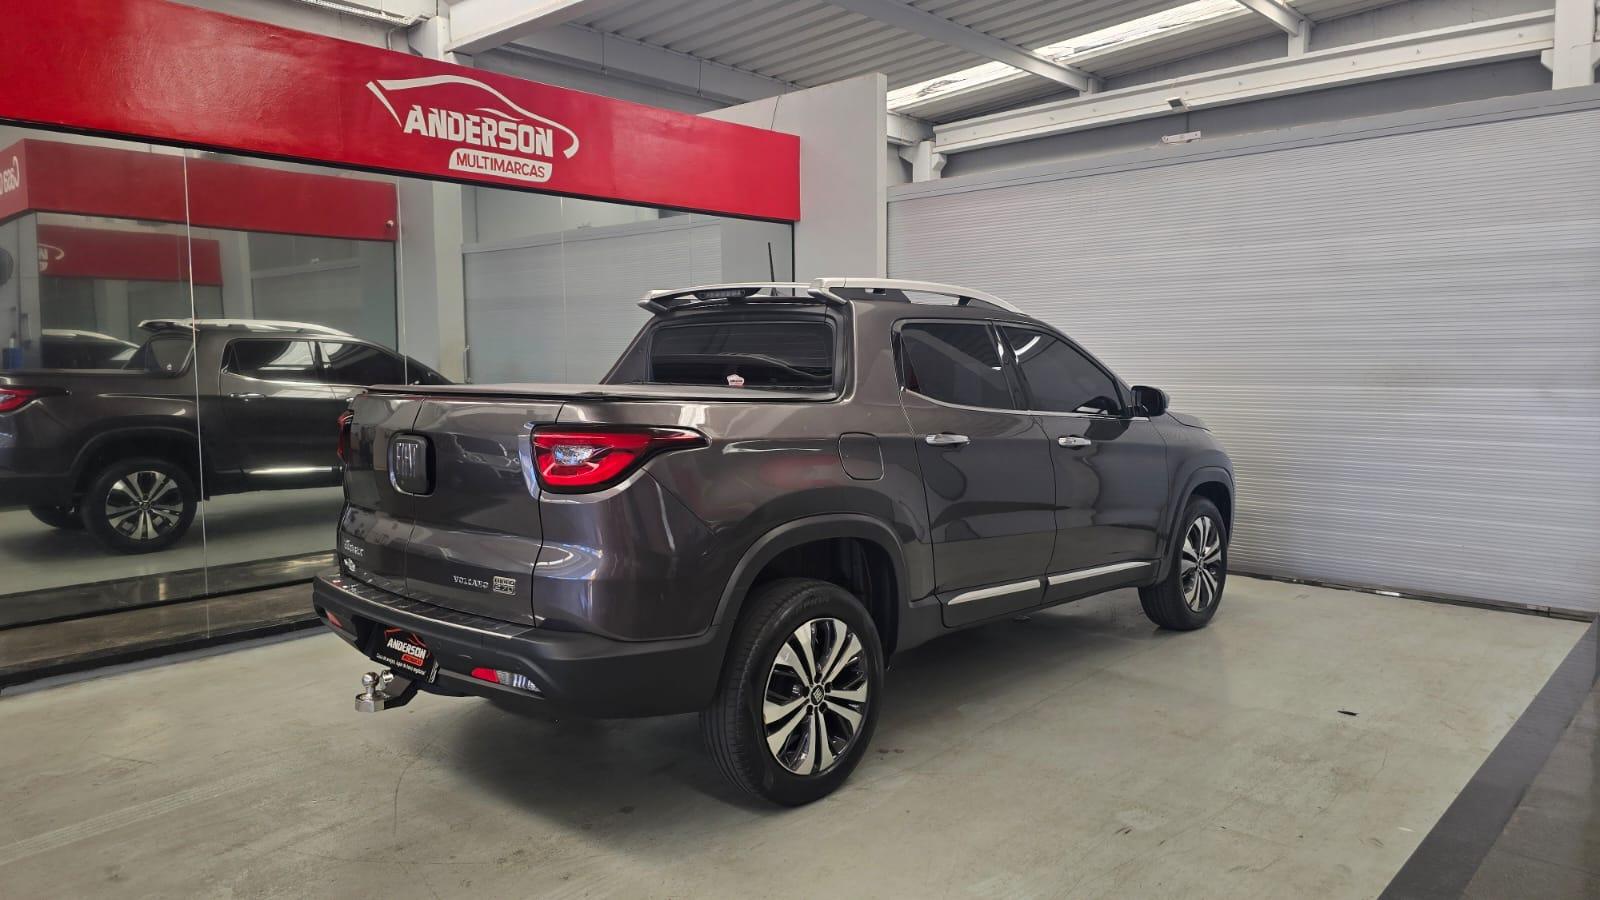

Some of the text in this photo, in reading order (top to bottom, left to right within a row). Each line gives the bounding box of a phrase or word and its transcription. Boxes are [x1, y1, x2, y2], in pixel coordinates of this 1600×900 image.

[403, 104, 554, 157] ANDERSON
[456, 151, 545, 179] MULTIMARCAS
[386, 637, 427, 660] ANDERSON
